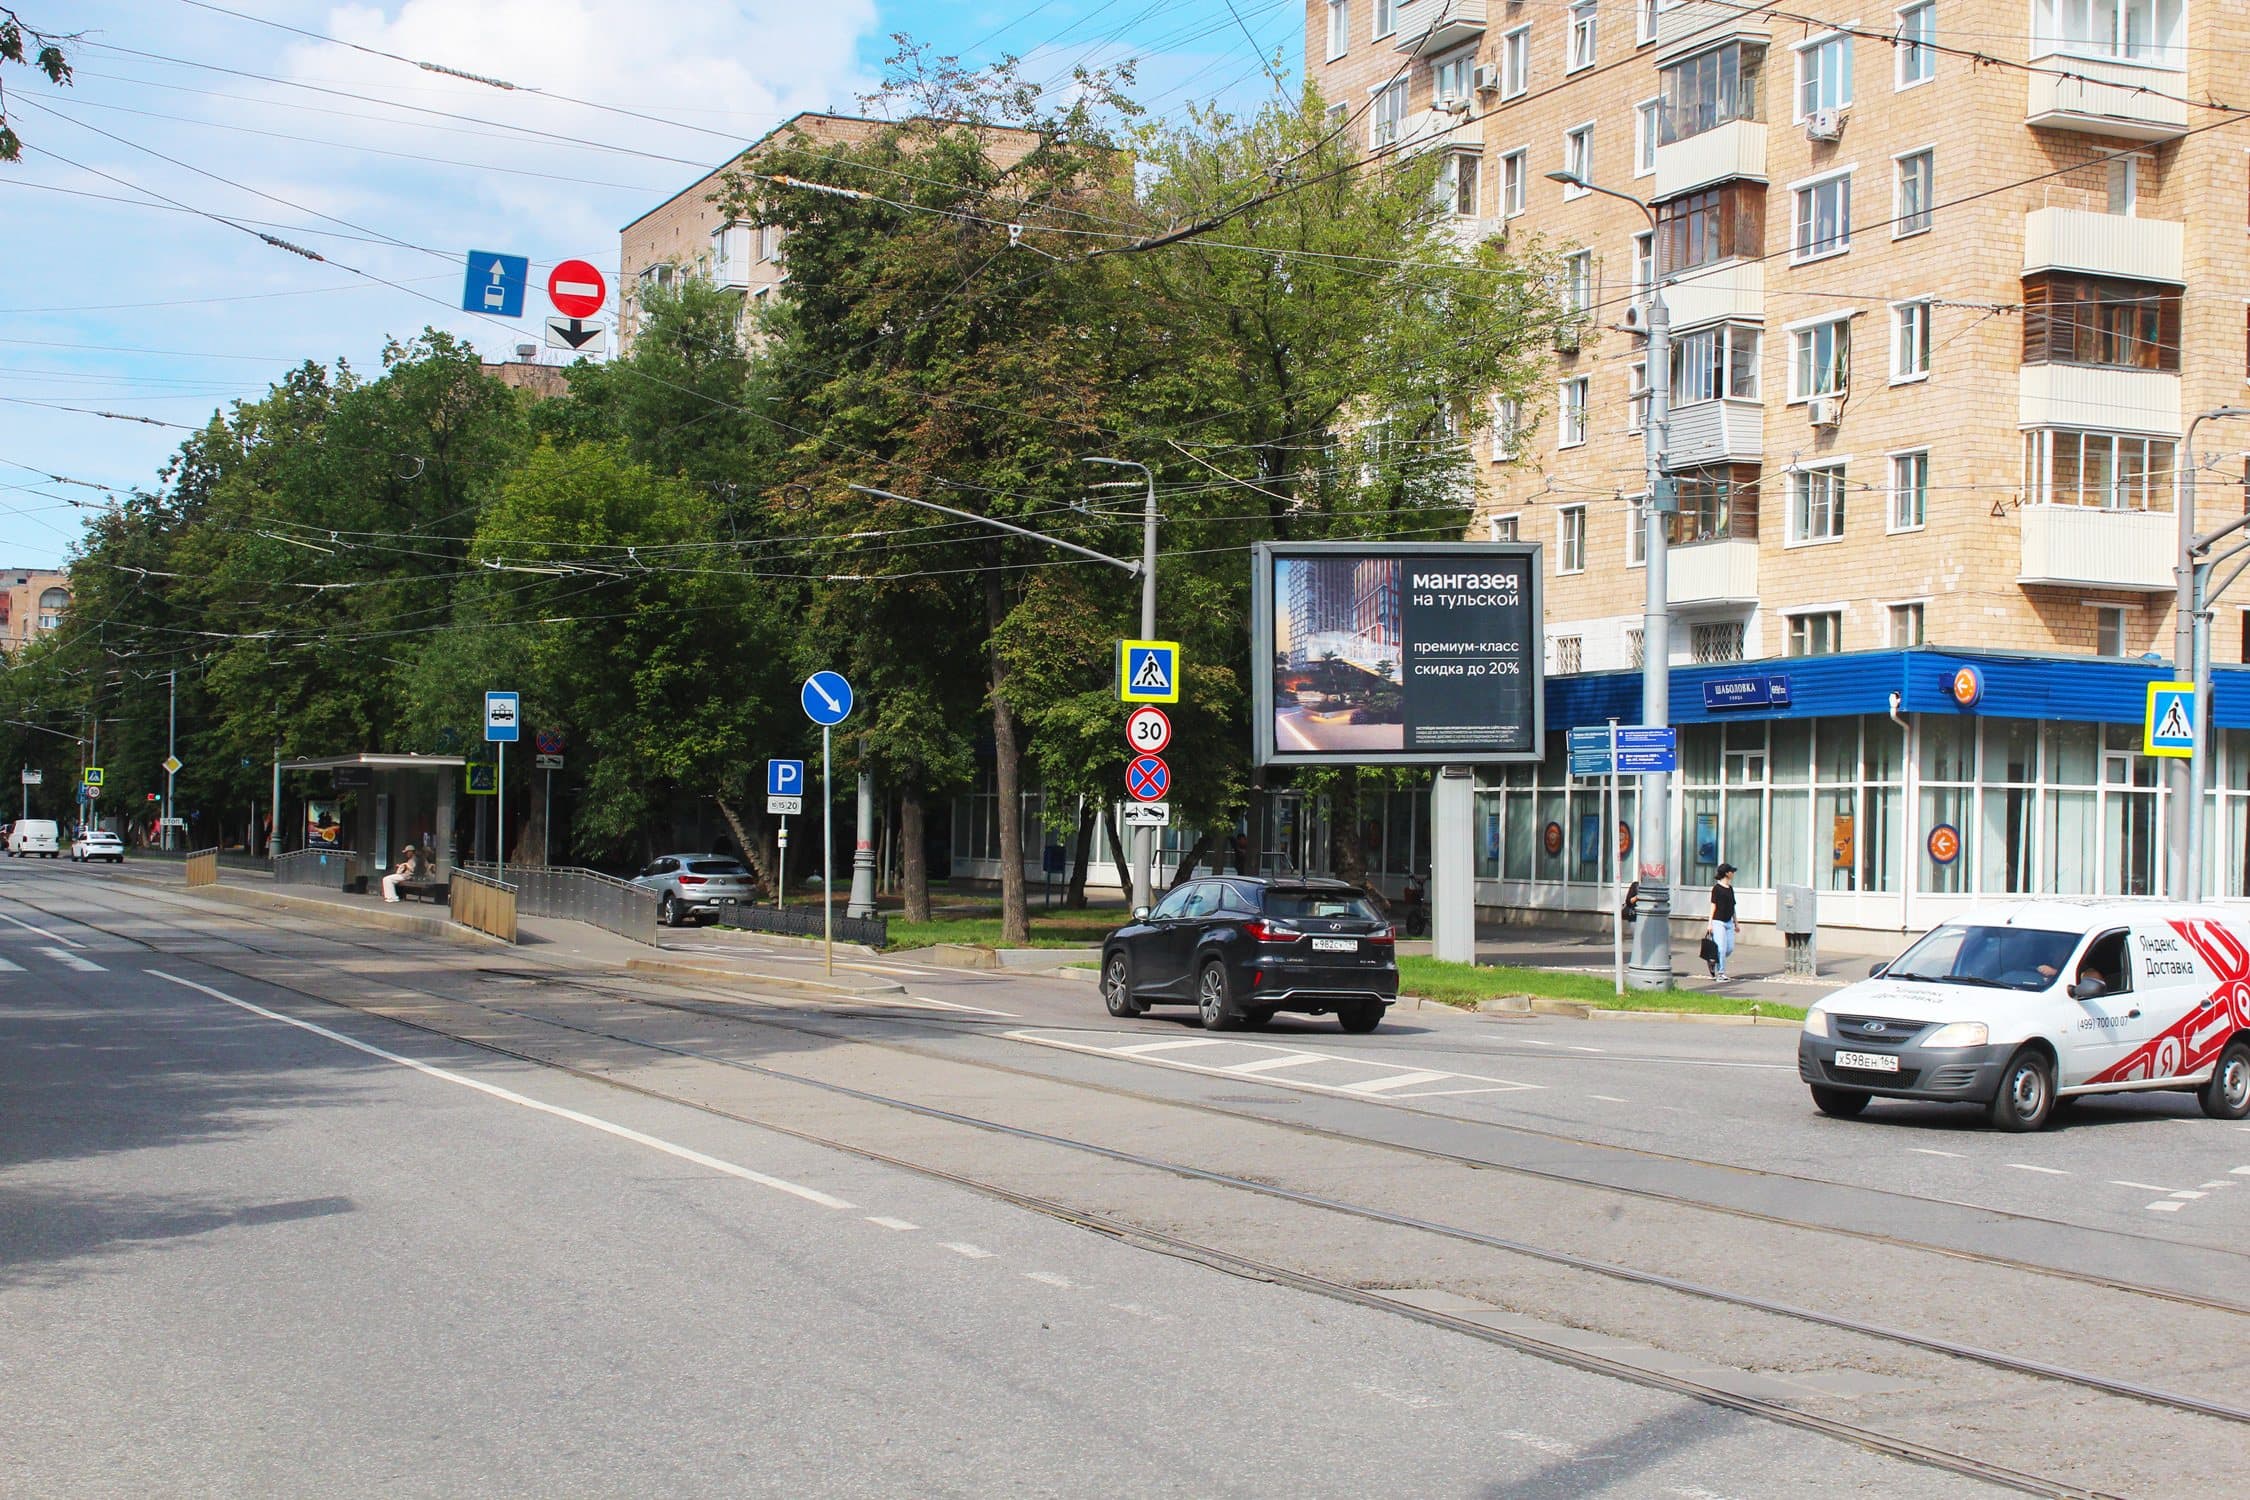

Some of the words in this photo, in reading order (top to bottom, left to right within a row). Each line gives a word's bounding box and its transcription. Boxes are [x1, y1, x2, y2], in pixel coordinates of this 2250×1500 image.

[1413, 573, 1518, 590] мангазея
[1413, 594, 1434, 606] на
[1438, 590, 1519, 609] тульской
[1414, 642, 1519, 655] премиум-класс
[1414, 665, 1463, 677] скидка
[1467, 665, 1486, 677] до
[1488, 662, 1520, 675] 20%
[1715, 683, 1756, 694] ШАБОЛОВКА
[1138, 721, 1162, 740] 30
[777, 764, 797, 791] P
[2139, 936, 2178, 952] Яндекс
[2145, 958, 2194, 977] Доставка
[2077, 1017, 2096, 1032] (499)
[2096, 1016, 2110, 1029] 700
[2110, 1016, 2119, 1028] 00
[2120, 1015, 2129, 1027] 07
[1880, 1056, 1897, 1066] 164
